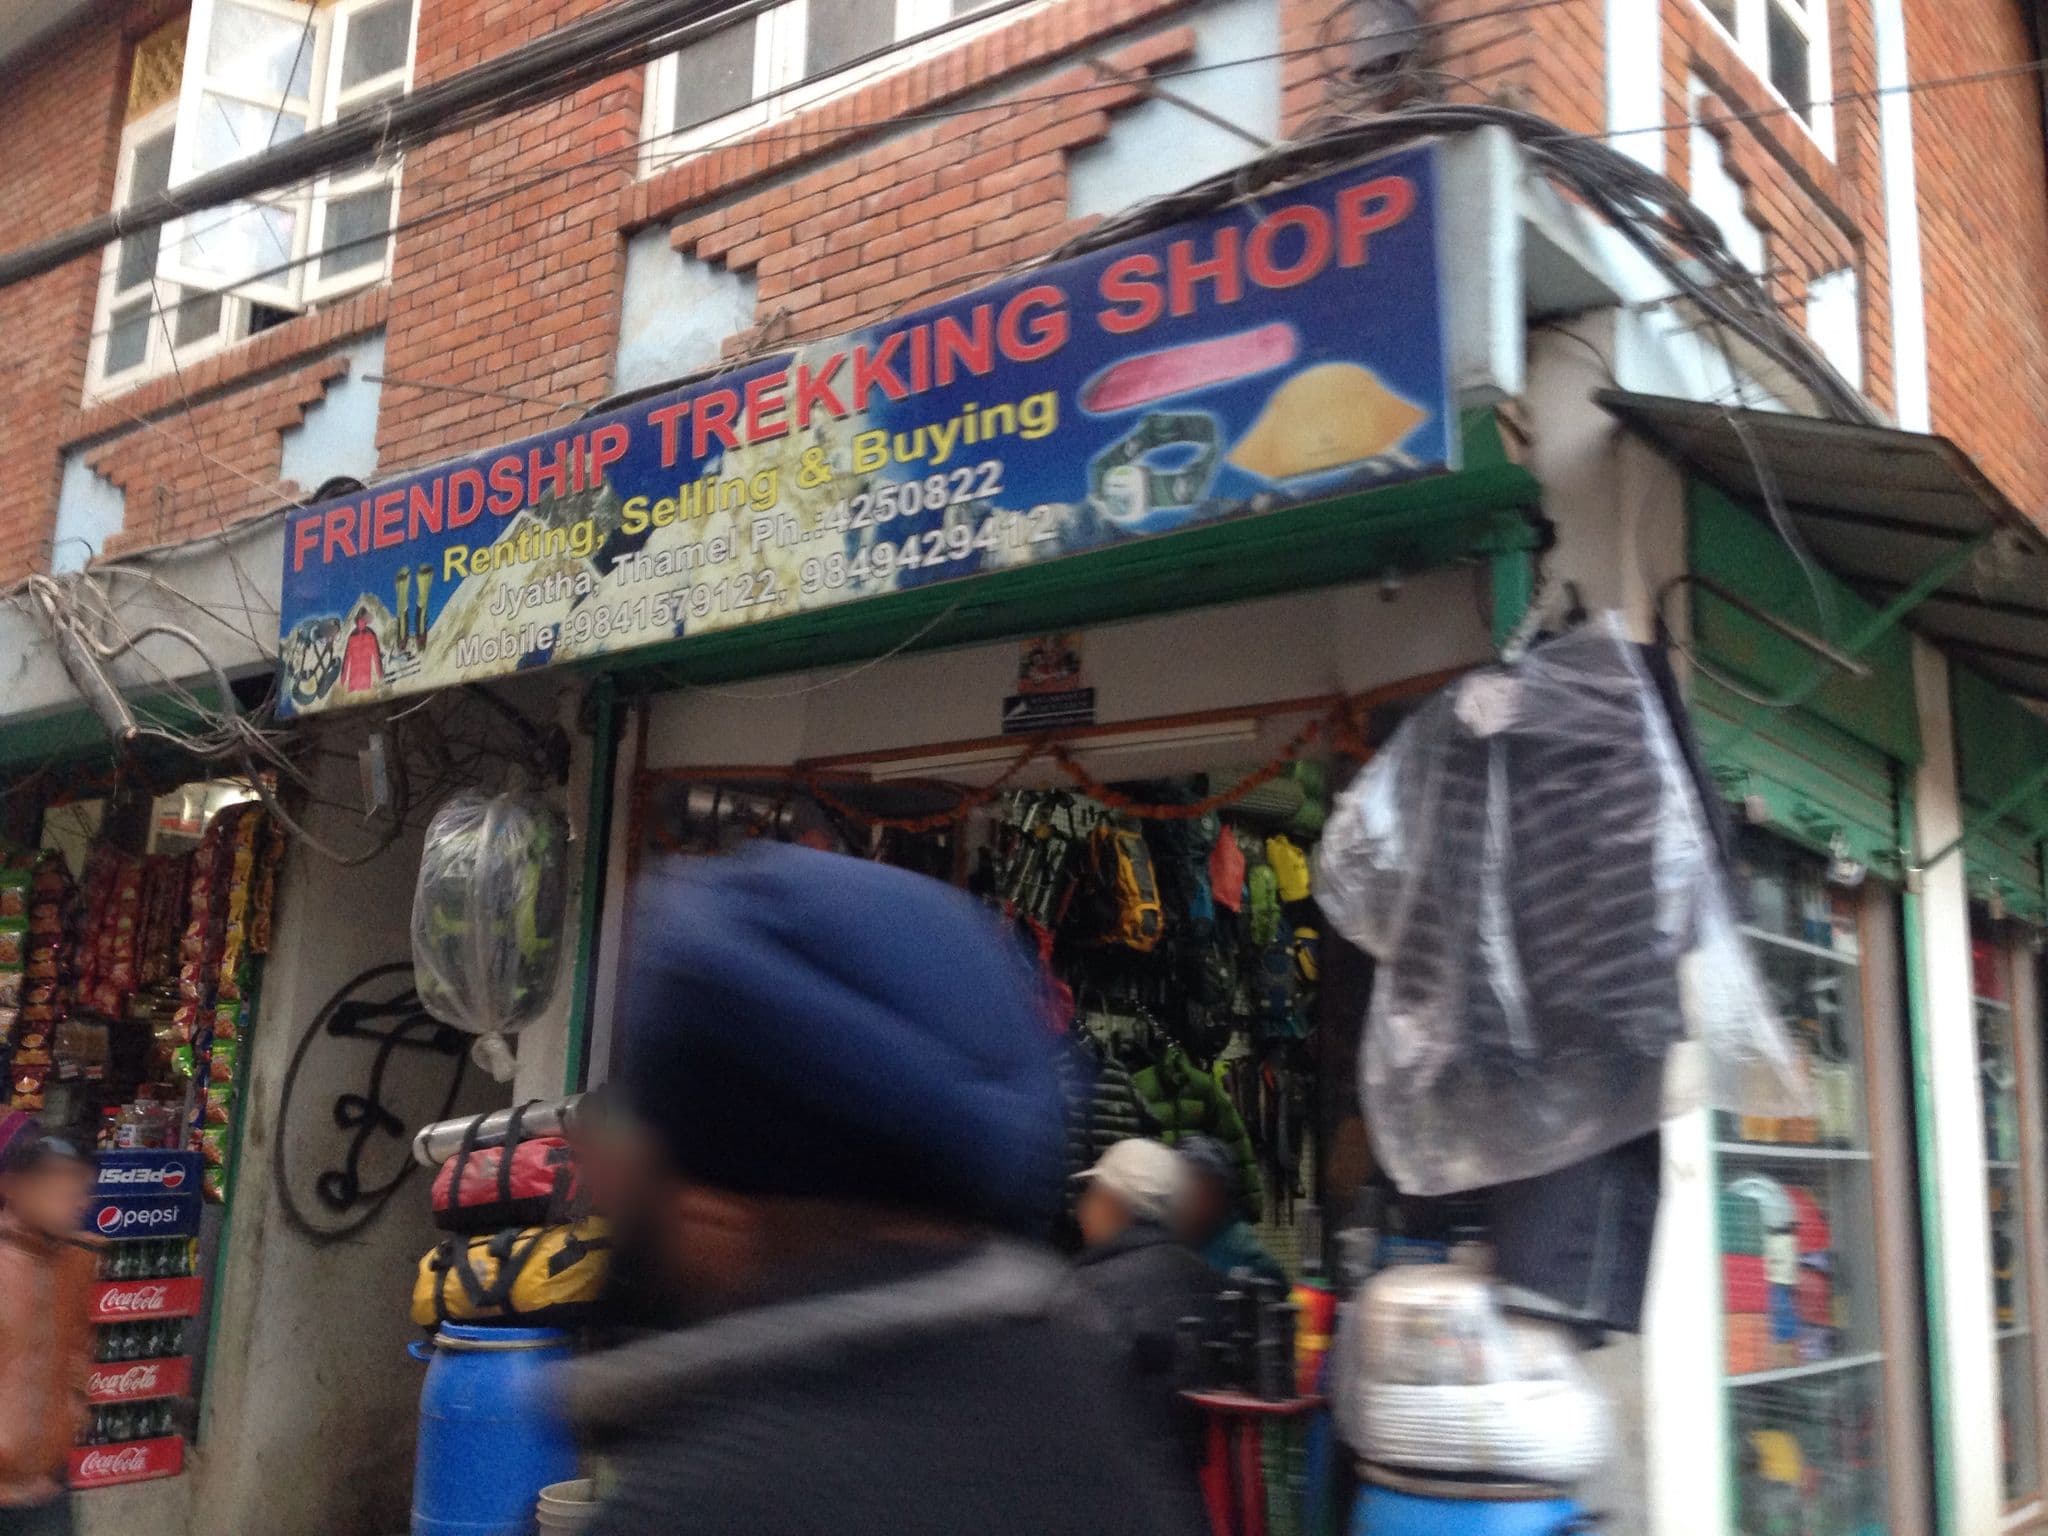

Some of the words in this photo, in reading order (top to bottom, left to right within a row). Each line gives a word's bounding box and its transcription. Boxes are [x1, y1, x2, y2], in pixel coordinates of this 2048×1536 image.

[294, 423, 630, 572] FRIENDSHIP
[648, 285, 1071, 468] TREKKING
[1097, 175, 1418, 335] SHOP
[443, 518, 606, 582] Renting,
[620, 462, 779, 535] Selling
[796, 447, 833, 490] &
[852, 391, 1059, 475] Buying
[489, 569, 602, 621] Jyatha,
[611, 525, 737, 588] Thamel
[800, 504, 1058, 595] 9849429412
[123, 1205, 179, 1228] pepsi
